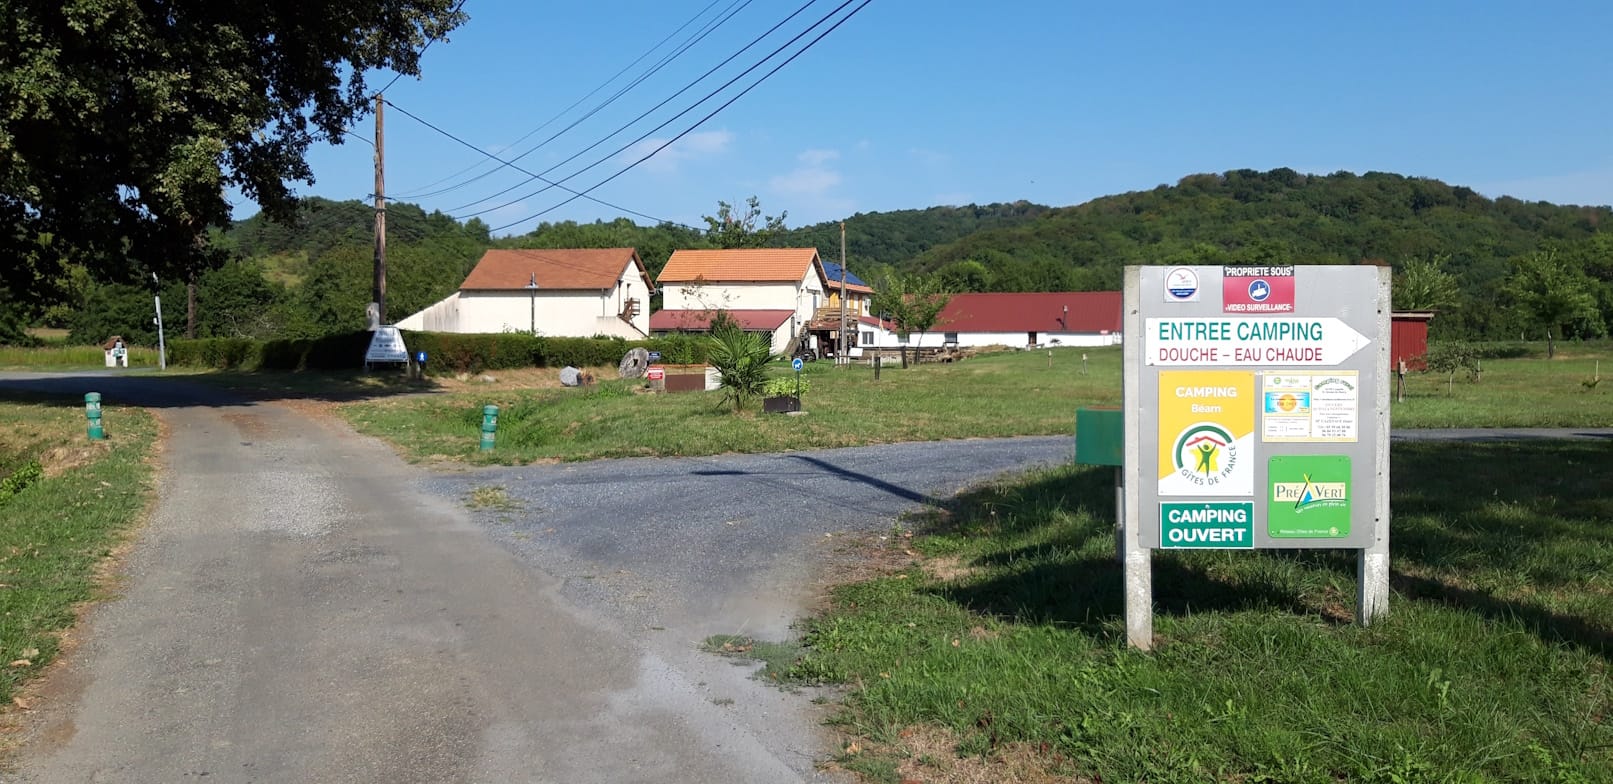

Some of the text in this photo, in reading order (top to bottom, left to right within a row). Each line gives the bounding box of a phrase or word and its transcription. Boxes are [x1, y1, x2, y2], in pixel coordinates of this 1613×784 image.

[1226, 267, 1291, 276] PROPRIETE SOUS
[1159, 322, 1323, 341] ENTREE CAMPING
[1159, 348, 1218, 362] DOUCHE
[1235, 348, 1262, 362] EAU
[1266, 348, 1322, 362] CHAUDE
[1175, 386, 1238, 398] CAMPING
[1208, 476, 1220, 486] DE
[1221, 445, 1237, 479] FRANCE
[1168, 509, 1247, 523] CAMPING
[1168, 528, 1247, 542] OUVERT
